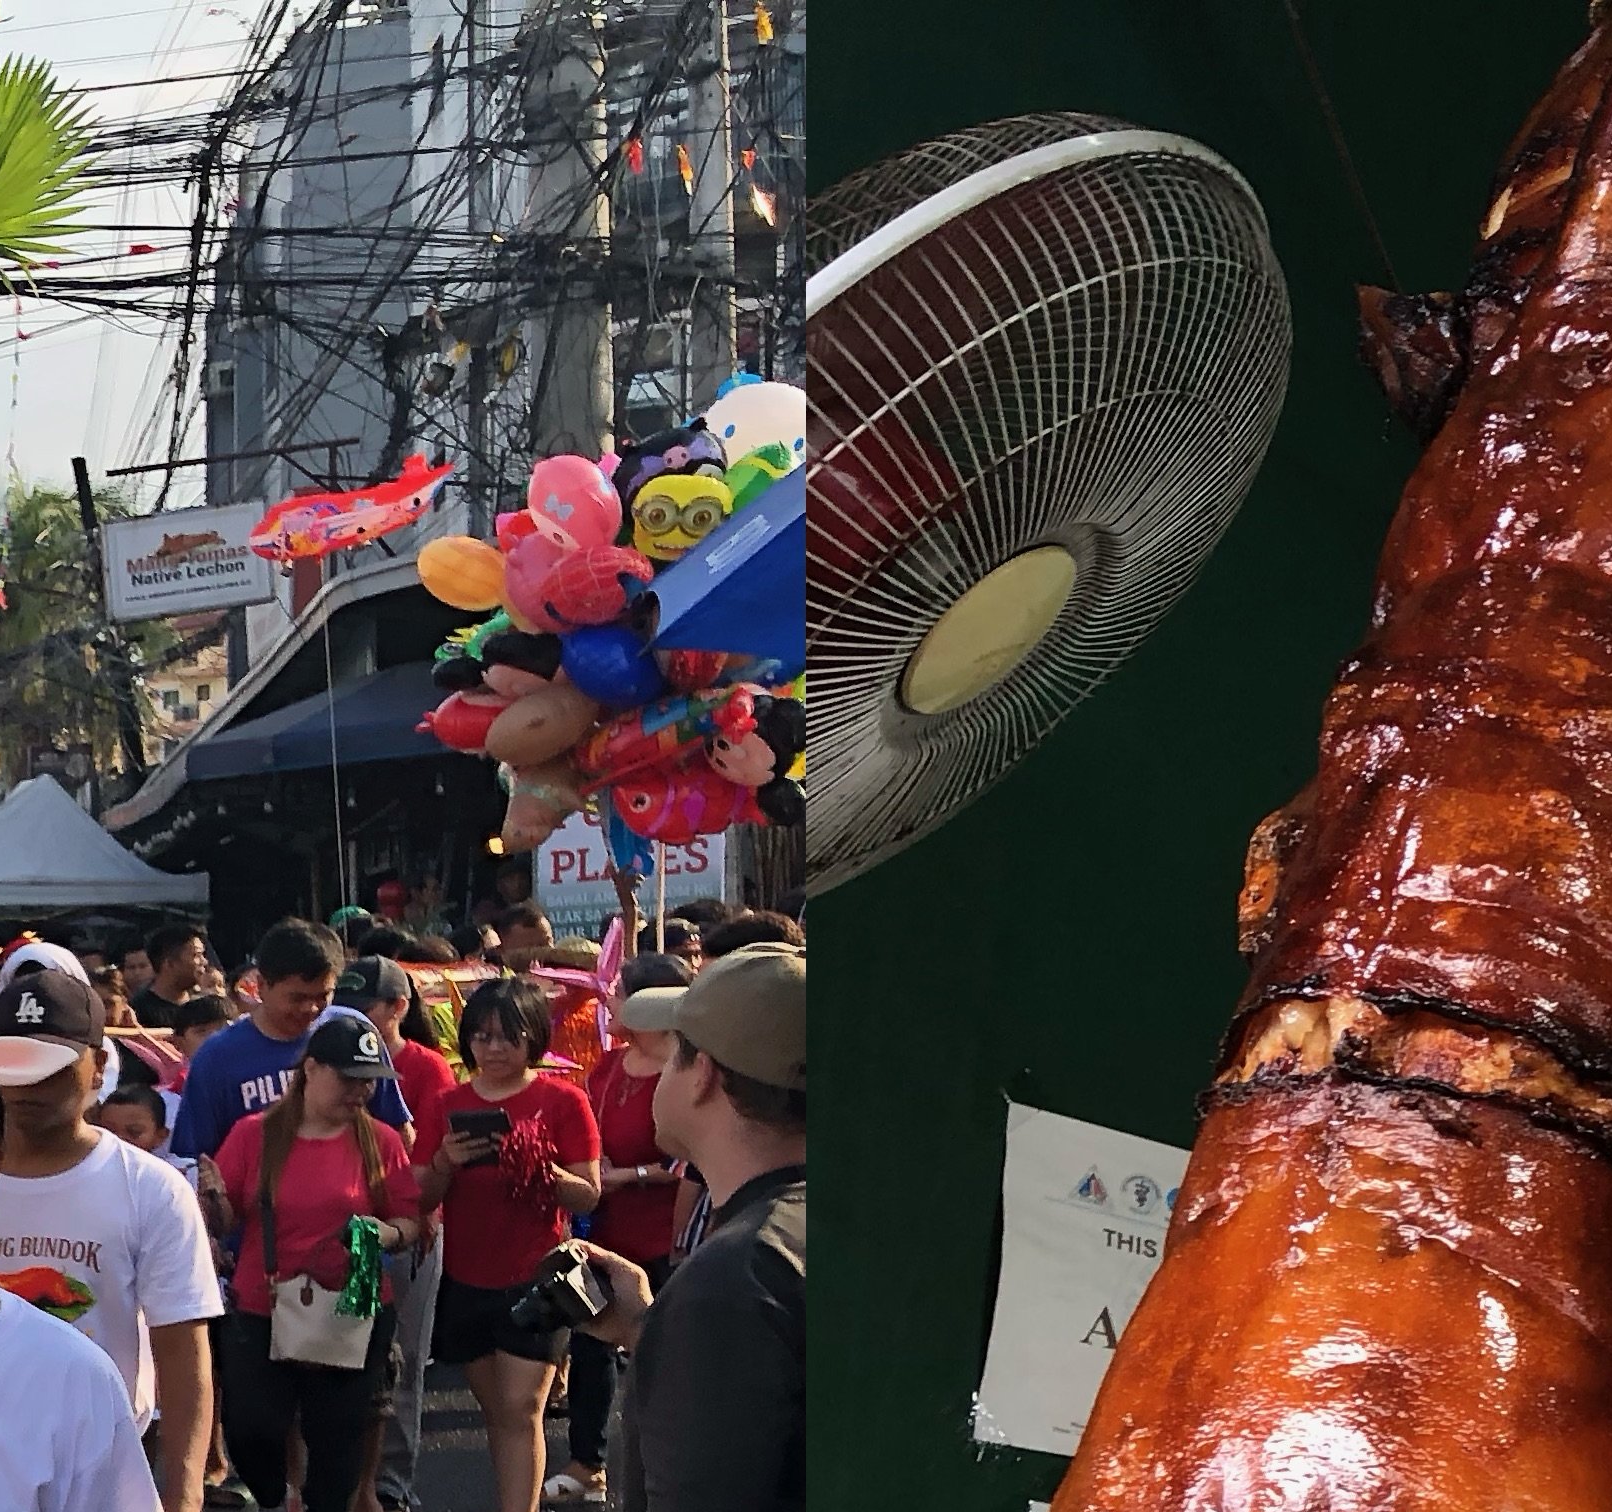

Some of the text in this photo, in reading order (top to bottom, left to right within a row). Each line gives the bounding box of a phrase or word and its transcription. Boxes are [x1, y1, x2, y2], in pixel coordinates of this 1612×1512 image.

[132, 560, 245, 586] Native Lechon
[550, 838, 709, 884] PLES
[20, 1236, 102, 1273] BUNDOK
[1102, 1227, 1158, 1258] THIS
